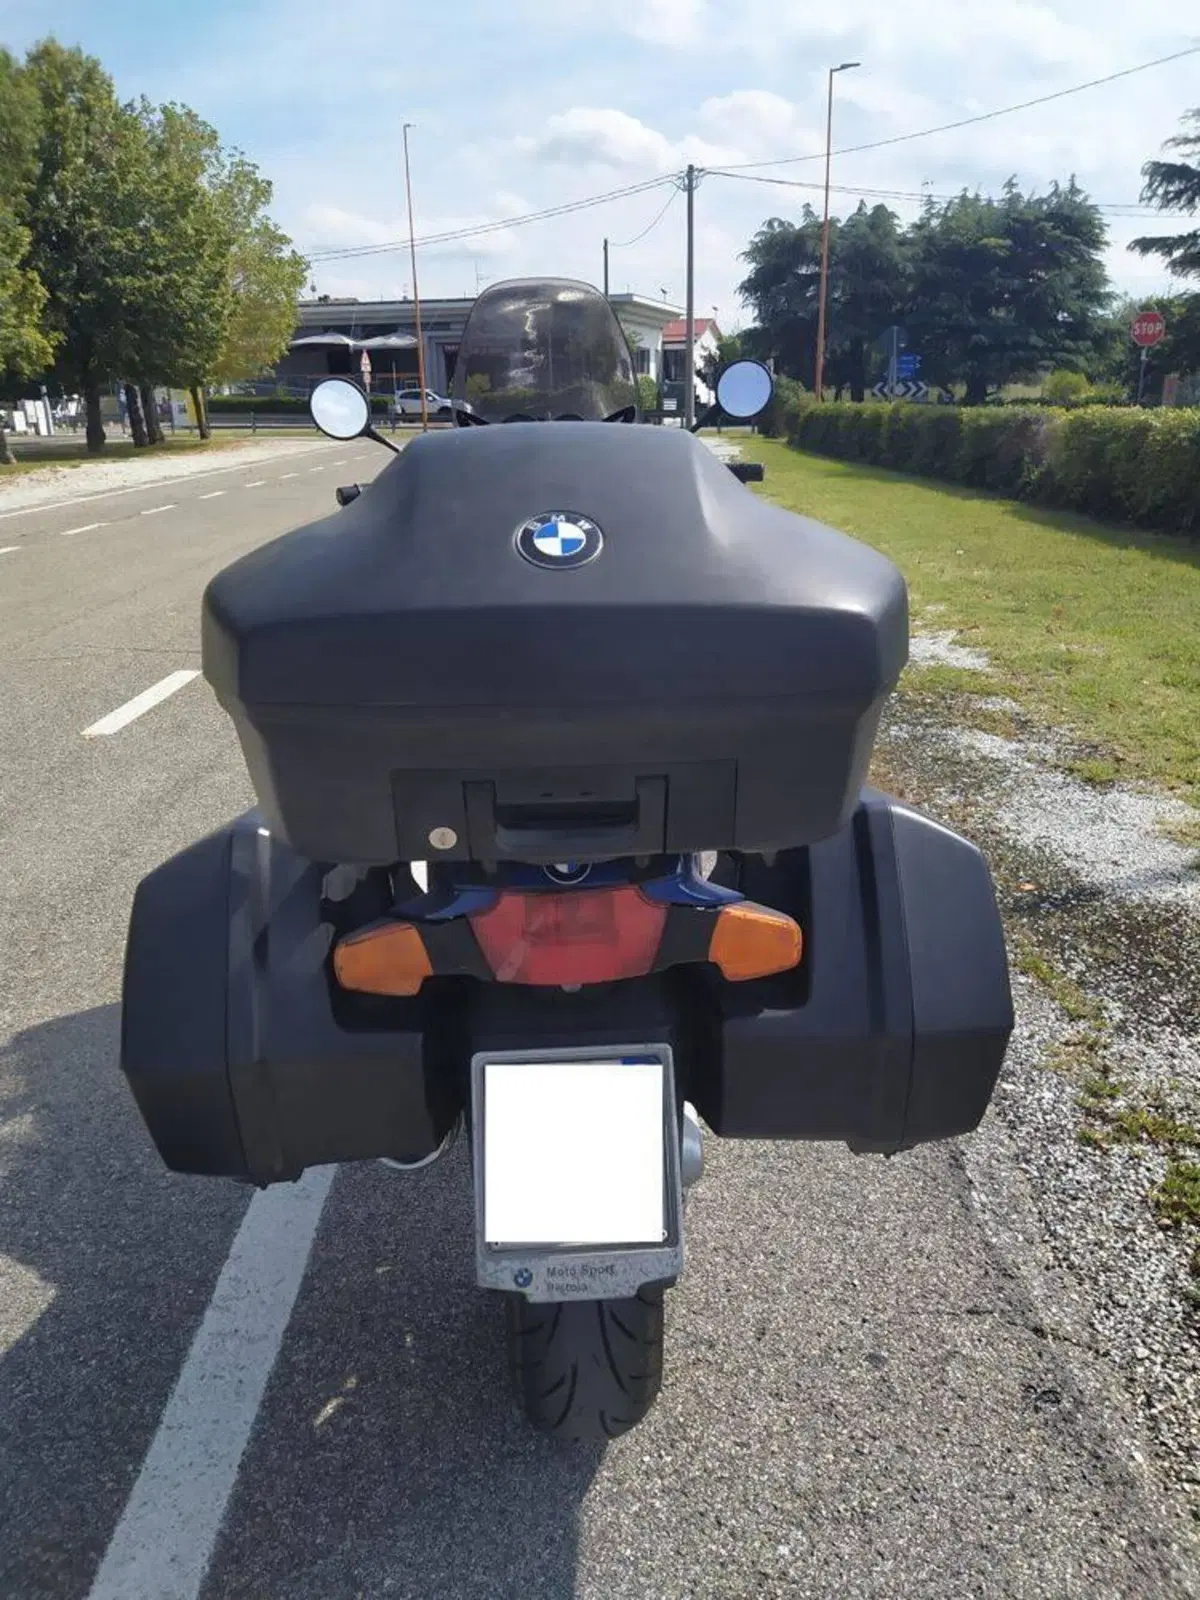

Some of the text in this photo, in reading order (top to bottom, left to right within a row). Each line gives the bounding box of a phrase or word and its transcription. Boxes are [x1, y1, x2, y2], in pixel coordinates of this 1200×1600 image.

[1134, 322, 1162, 336] STOP
[525, 514, 592, 530] BMW
[546, 1263, 615, 1279] Moto Sport
